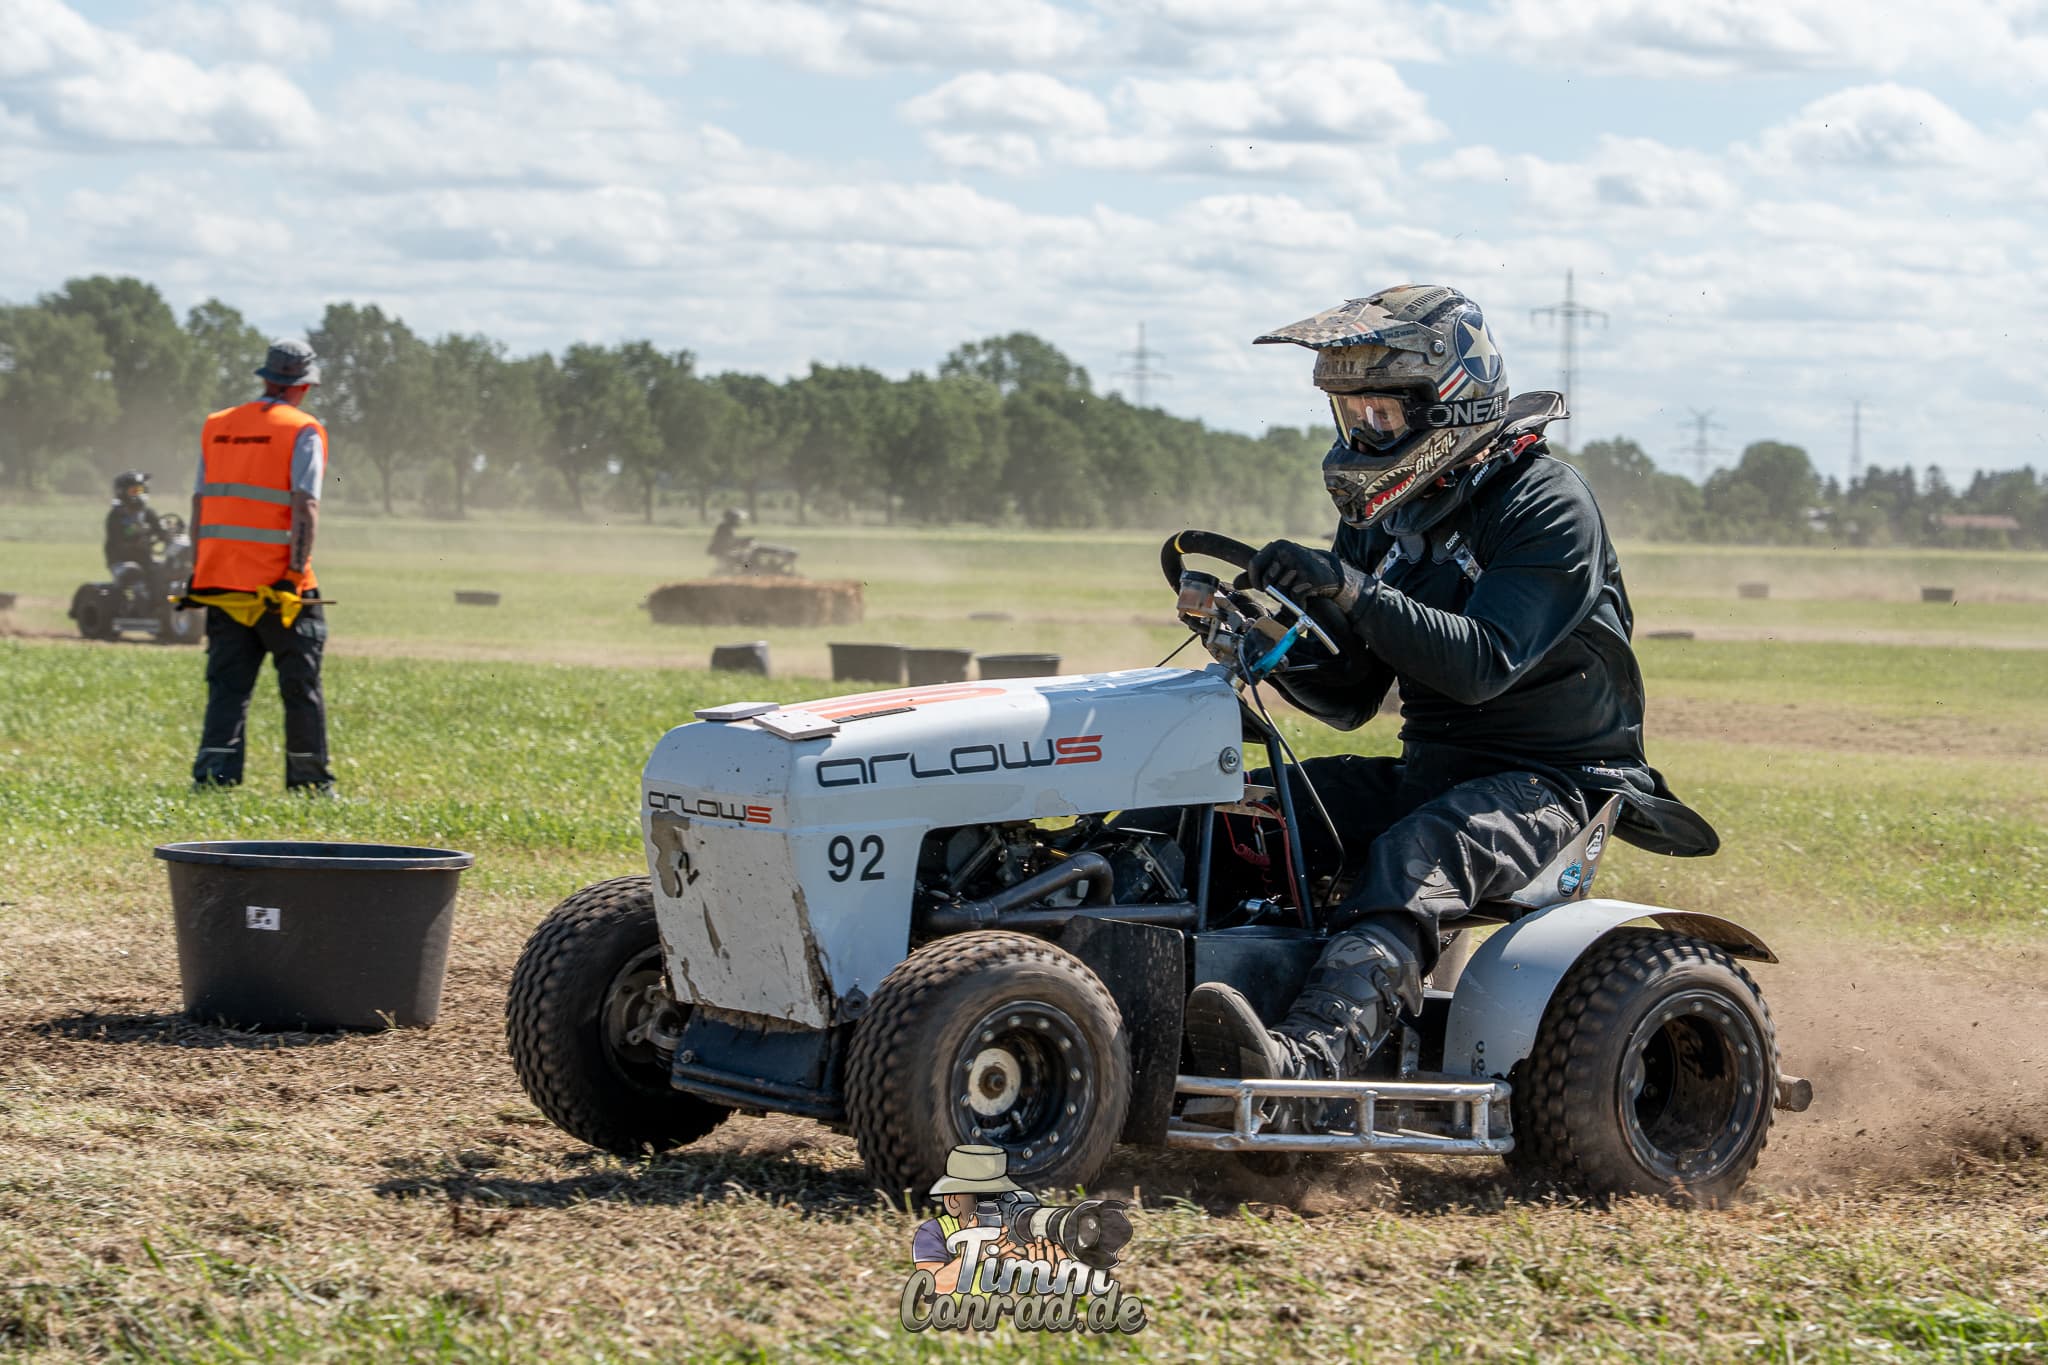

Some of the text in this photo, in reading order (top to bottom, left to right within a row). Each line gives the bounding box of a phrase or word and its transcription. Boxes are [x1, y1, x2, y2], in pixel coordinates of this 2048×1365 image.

[1426, 396, 1507, 428] O'NEAL
[1415, 430, 1458, 475] O'NEAL
[827, 834, 885, 882] 92
